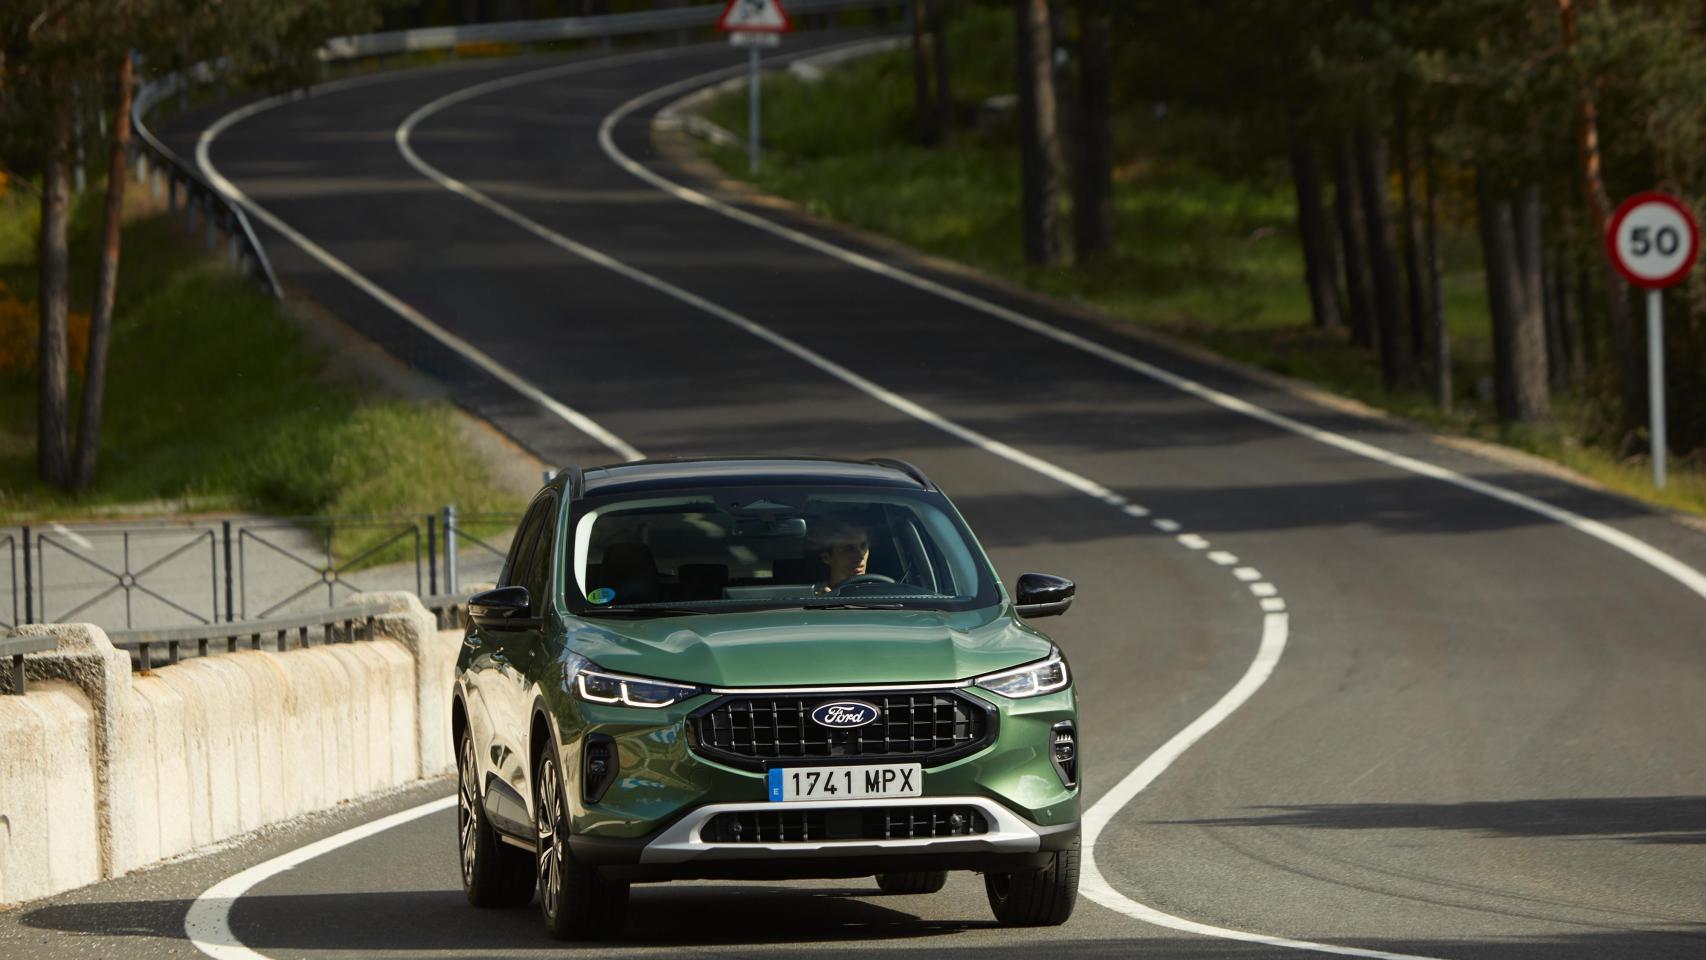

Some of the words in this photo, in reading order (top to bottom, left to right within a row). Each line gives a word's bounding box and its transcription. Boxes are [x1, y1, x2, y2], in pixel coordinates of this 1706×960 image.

[1631, 226, 1679, 257] 50
[824, 706, 864, 723] Ford
[773, 787, 780, 796] E
[792, 771, 852, 796] 1741
[865, 768, 914, 793] MPX
